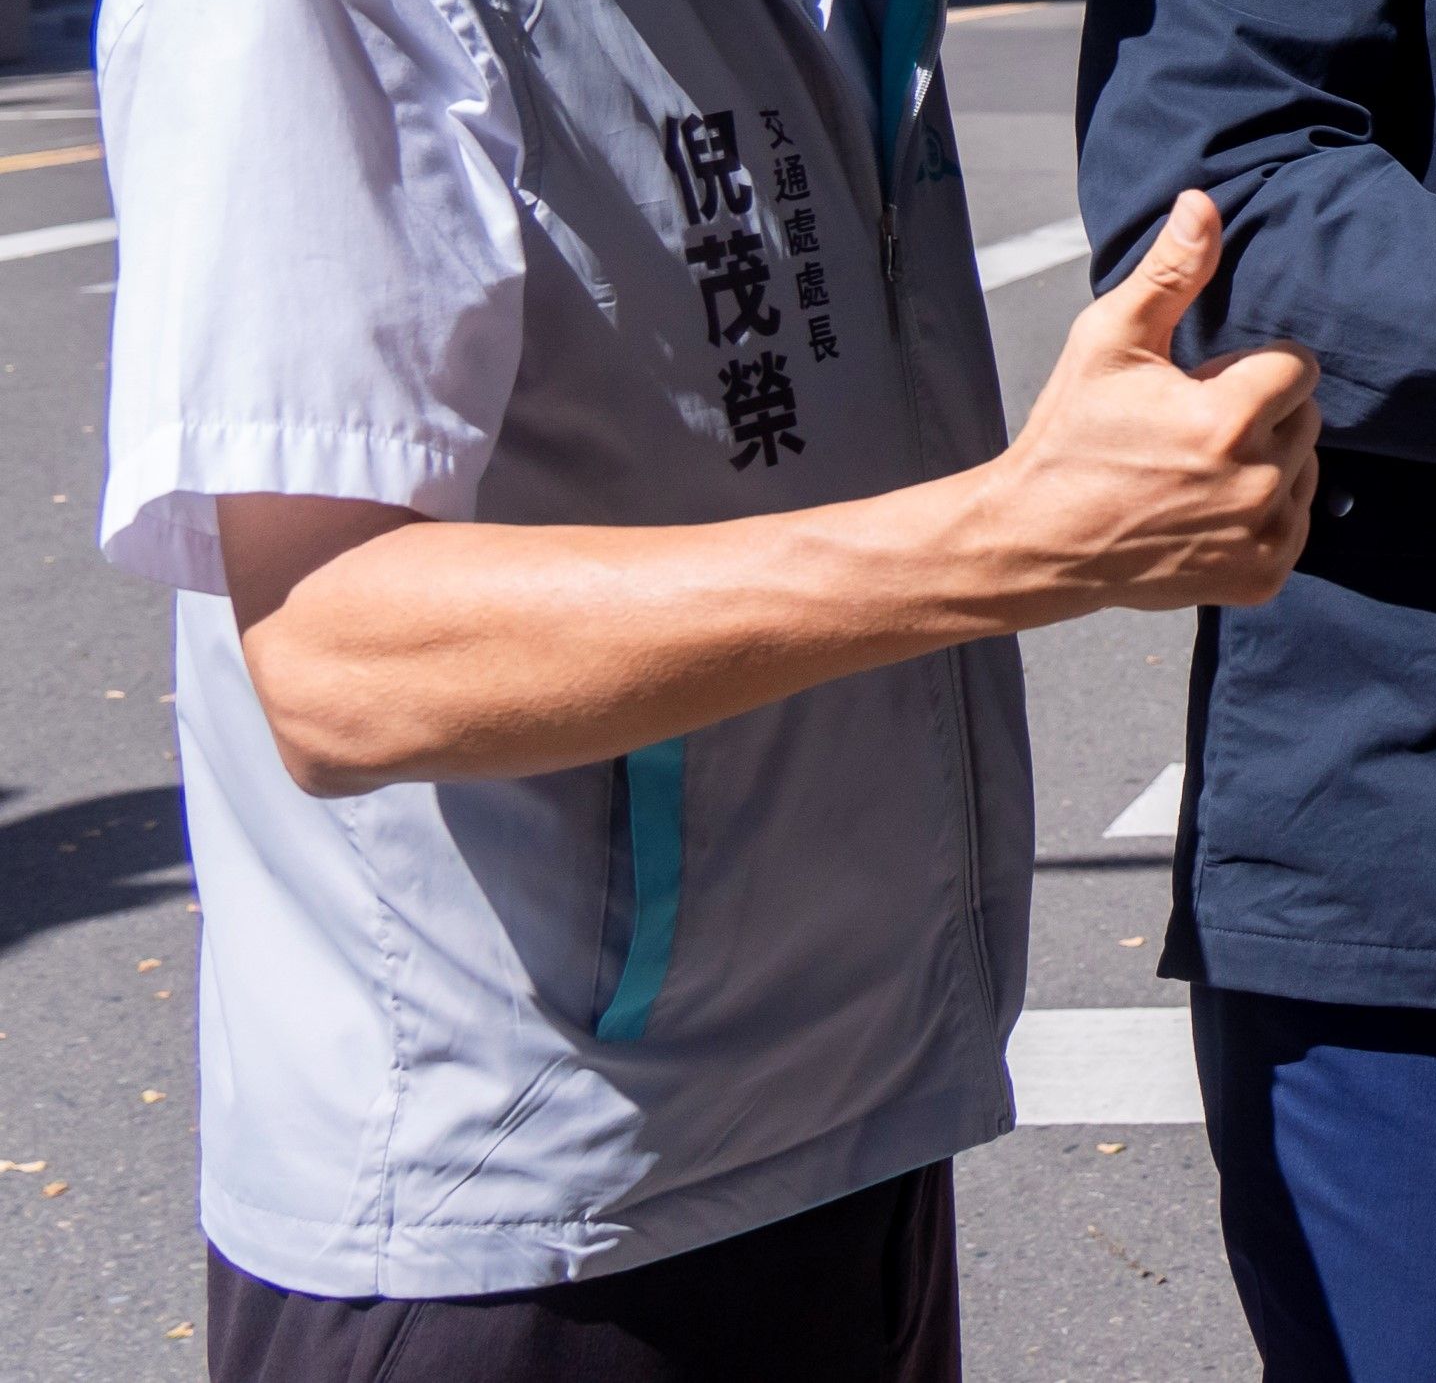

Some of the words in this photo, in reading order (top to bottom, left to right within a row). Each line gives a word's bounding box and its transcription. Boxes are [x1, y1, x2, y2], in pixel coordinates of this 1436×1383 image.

[663, 109, 806, 472] 倪茂榮
[758, 109, 840, 364] 交通處處長
